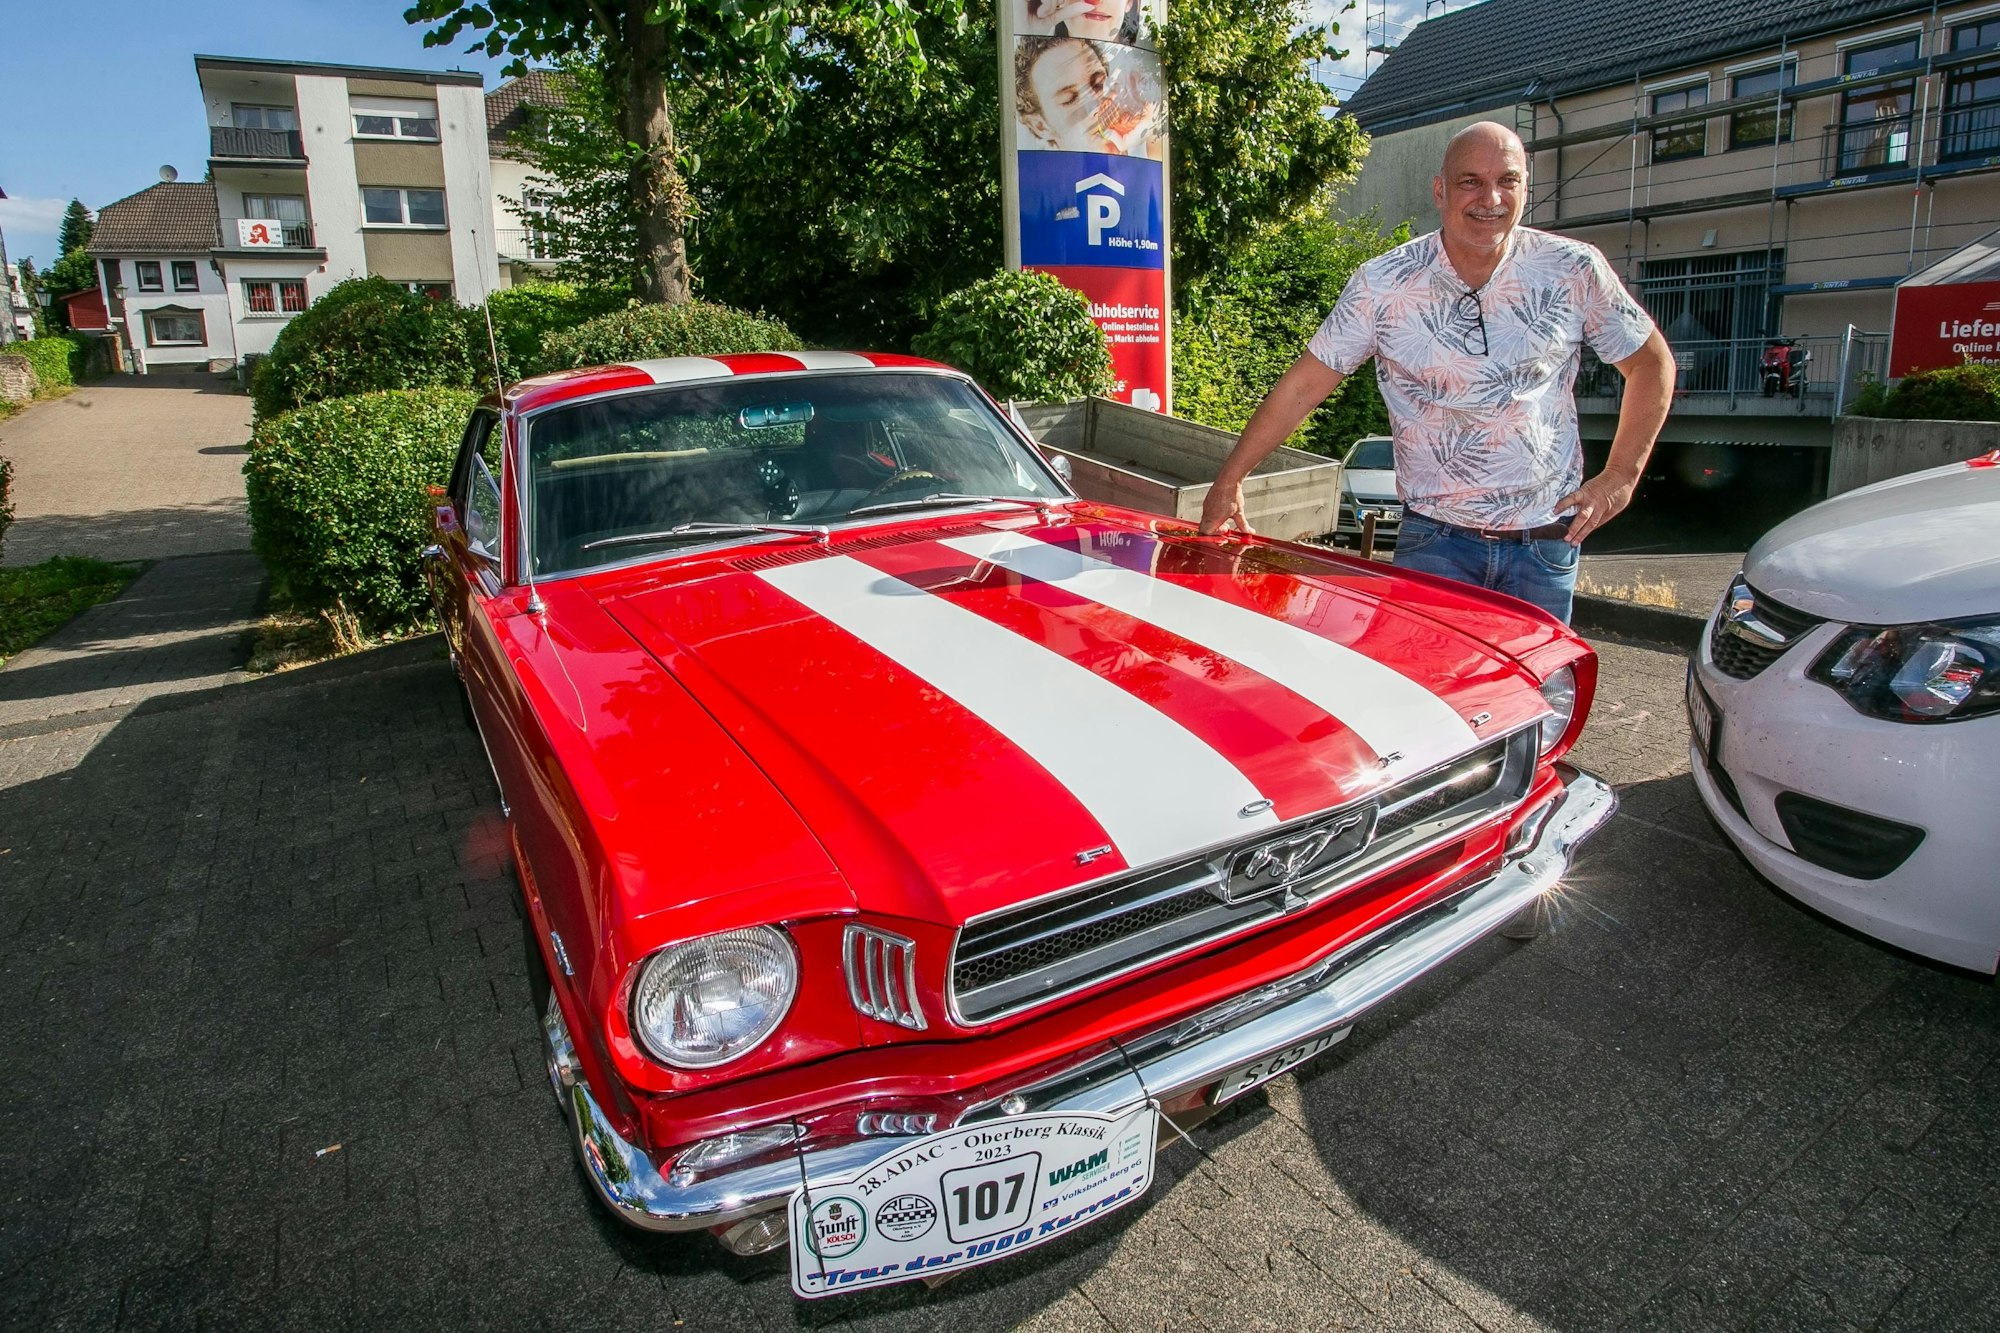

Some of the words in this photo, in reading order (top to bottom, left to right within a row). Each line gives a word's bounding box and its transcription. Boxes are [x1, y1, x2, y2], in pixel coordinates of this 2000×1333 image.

[1087, 194, 1121, 246] P
[1108, 236, 1133, 248] Höhe
[1133, 239, 1158, 250] 1,90m
[1086, 303, 1160, 319] Abholservice
[1101, 322, 1125, 331] Online
[1126, 323, 1153, 332] bestellen
[1154, 323, 1160, 331] &
[1114, 334, 1134, 343] Markt
[1135, 335, 1160, 343] abholen
[1952, 342, 1993, 353] Online
[964, 1125, 1052, 1149] Oberberg
[1057, 1122, 1107, 1140] Klassik
[974, 1144, 1012, 1163] 2023
[1061, 1176, 1109, 1201] Volksbank
[1109, 1165, 1129, 1180] Berg
[952, 1171, 1026, 1226] 107
[826, 1232, 856, 1245] KÖLSCH
[904, 1248, 962, 1273] der
[966, 1226, 1034, 1257] 1000
